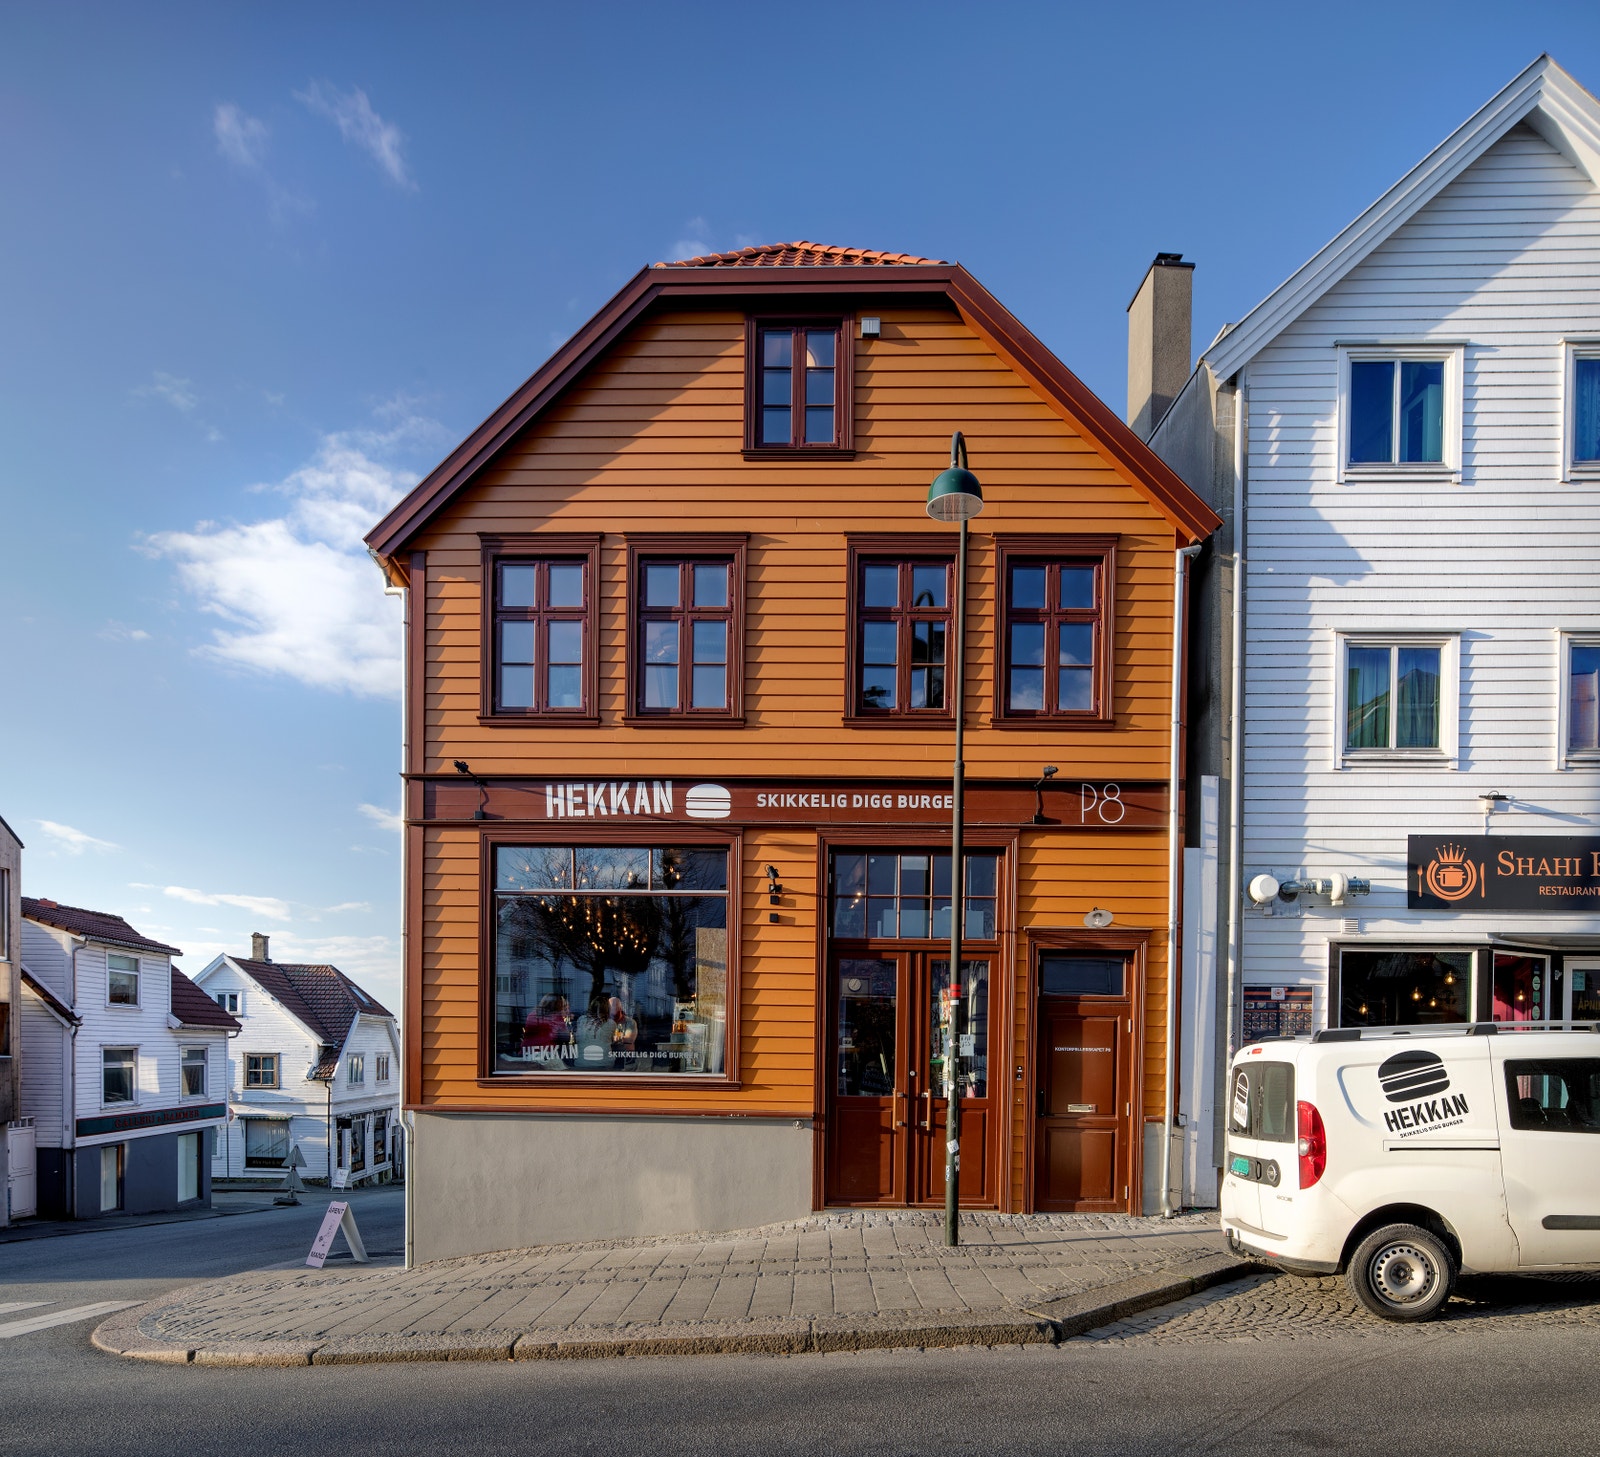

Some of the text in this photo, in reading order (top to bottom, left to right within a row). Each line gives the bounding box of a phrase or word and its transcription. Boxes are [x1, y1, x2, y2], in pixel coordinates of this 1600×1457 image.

[546, 780, 673, 819] HEKKAN
[756, 793, 954, 809] SKIKKELIG DIGG BURGE
[1081, 783, 1125, 824] P8
[521, 1044, 579, 1062] HEKKAN
[607, 1050, 648, 1059] SKIKKELIG
[649, 1050, 667, 1059] DIGG
[1383, 1093, 1469, 1133] HEKKAN
[1399, 1127, 1429, 1139] SKIKKELIG
